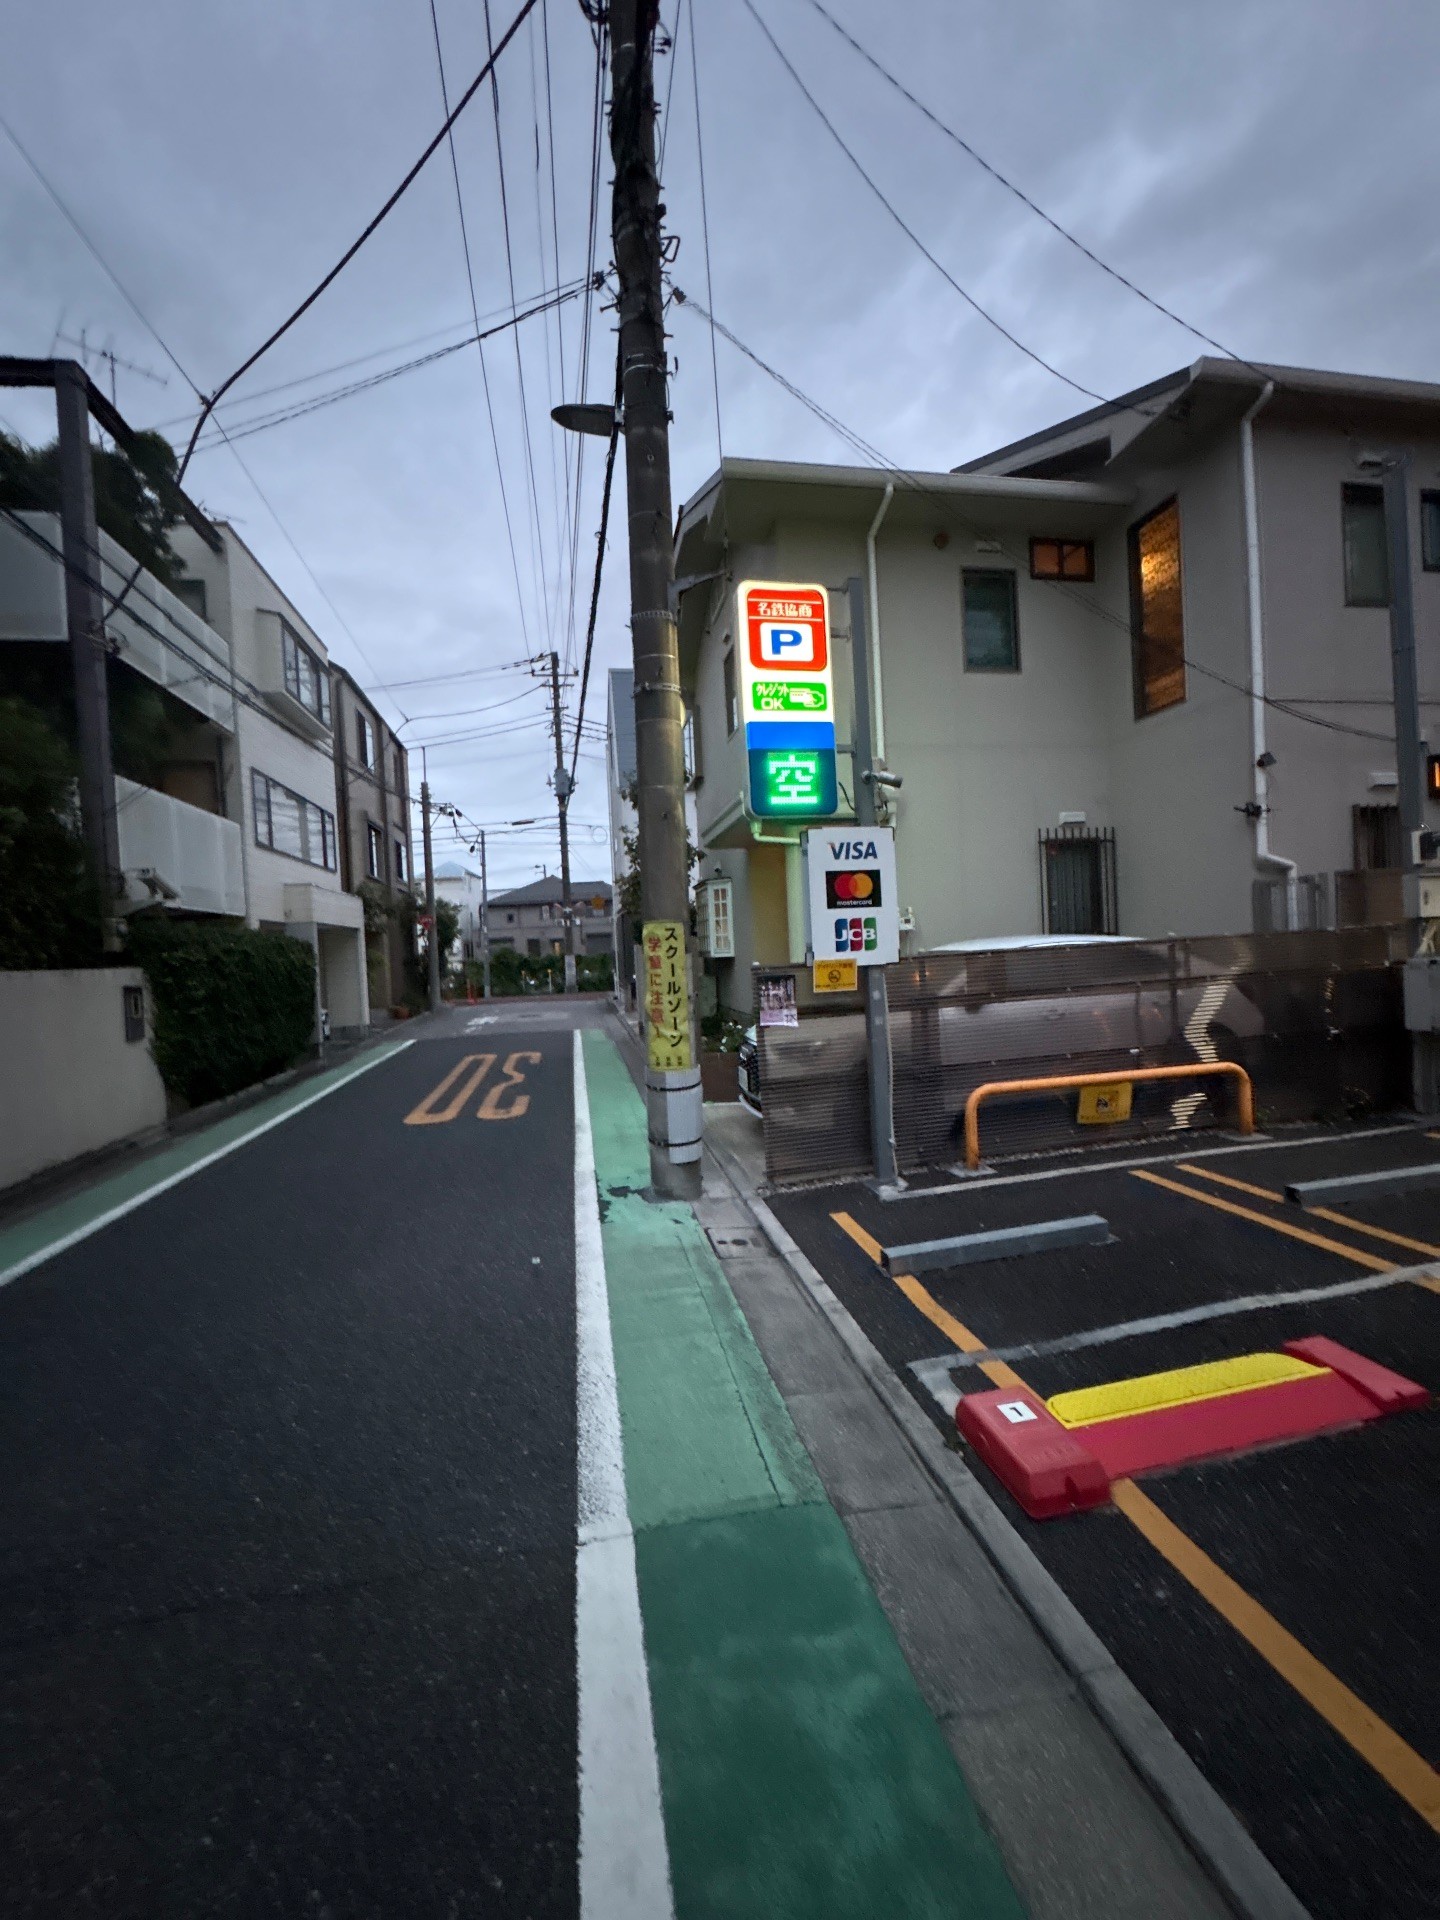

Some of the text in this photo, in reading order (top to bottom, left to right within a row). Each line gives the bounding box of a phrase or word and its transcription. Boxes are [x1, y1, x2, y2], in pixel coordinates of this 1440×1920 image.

[757, 601, 813, 617] 名鉄協商
[770, 629, 803, 655] P
[761, 697, 785, 710] OK
[768, 754, 819, 804] 空
[828, 841, 878, 860] VISA
[664, 926, 683, 1047] スクールゾーン
[403, 1050, 543, 1125] 30
[1009, 1406, 1023, 1417] 1
